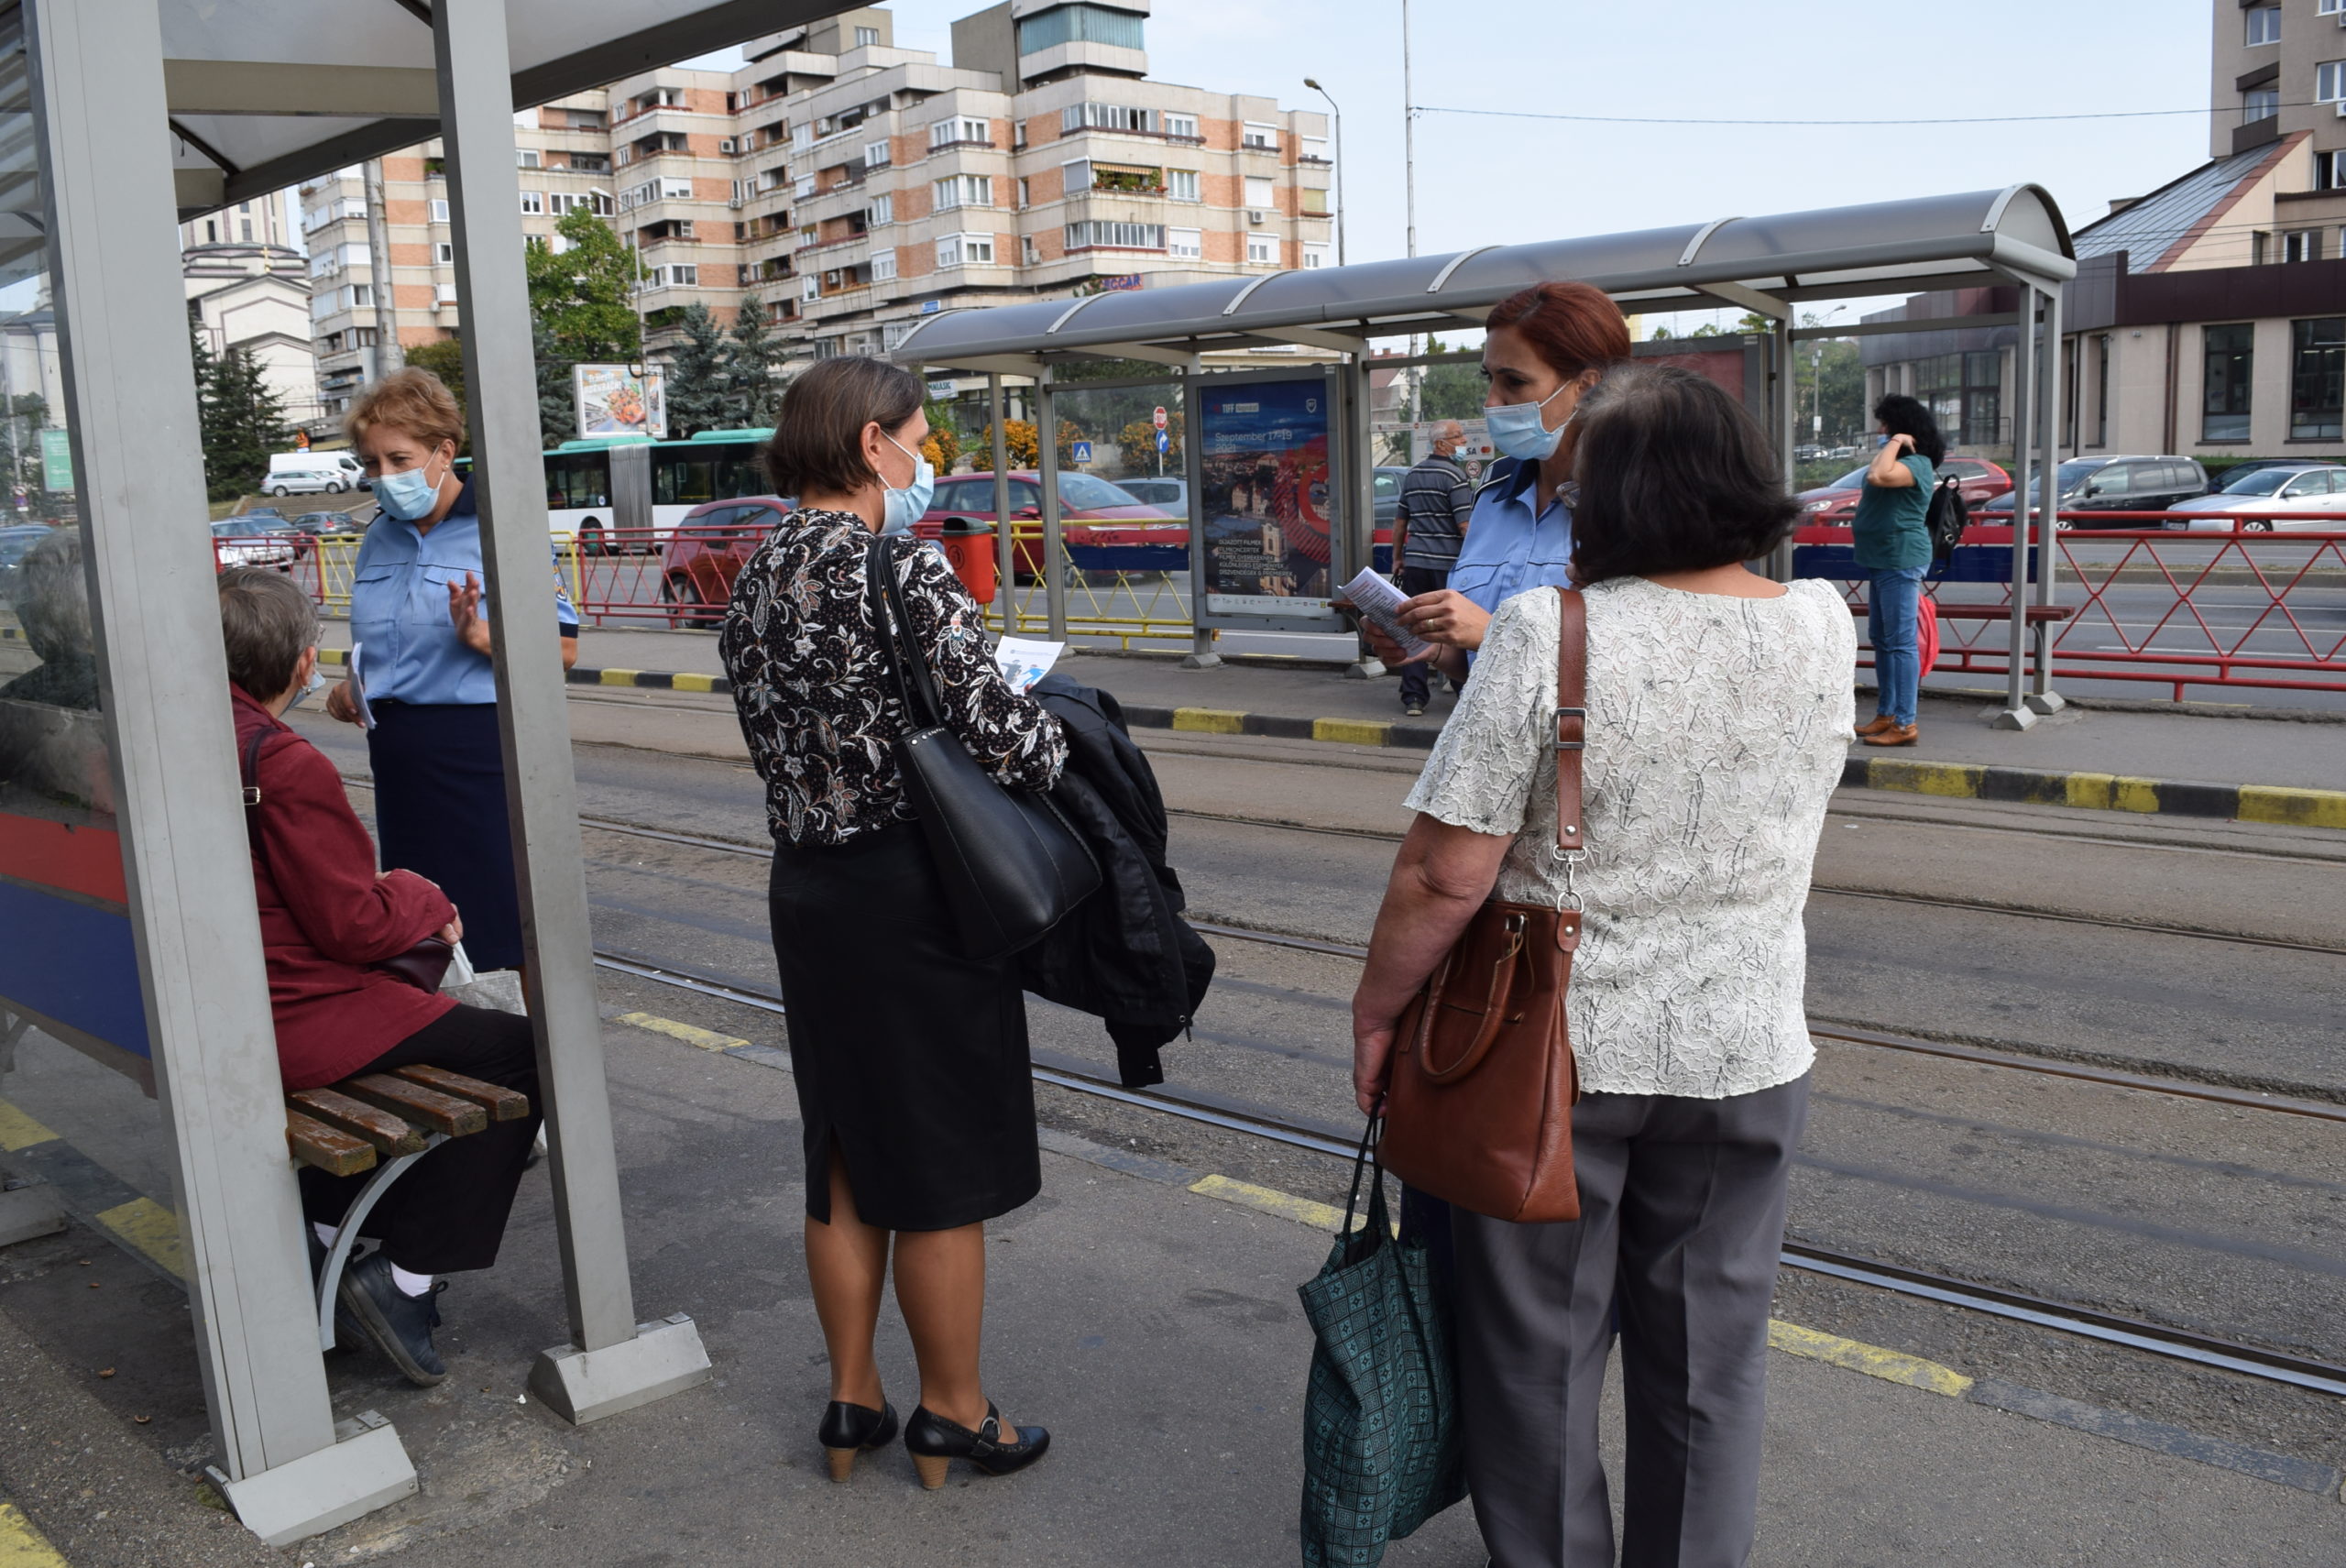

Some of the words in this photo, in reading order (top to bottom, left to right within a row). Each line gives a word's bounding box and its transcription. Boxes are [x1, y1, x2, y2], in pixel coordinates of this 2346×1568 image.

[1222, 403, 1235, 413] TIFF
[1154, 413, 1168, 423] STOP
[1215, 432, 1266, 443] Szeptember
[1267, 430, 1293, 441] 17-19
[1215, 444, 1236, 454] 2021
